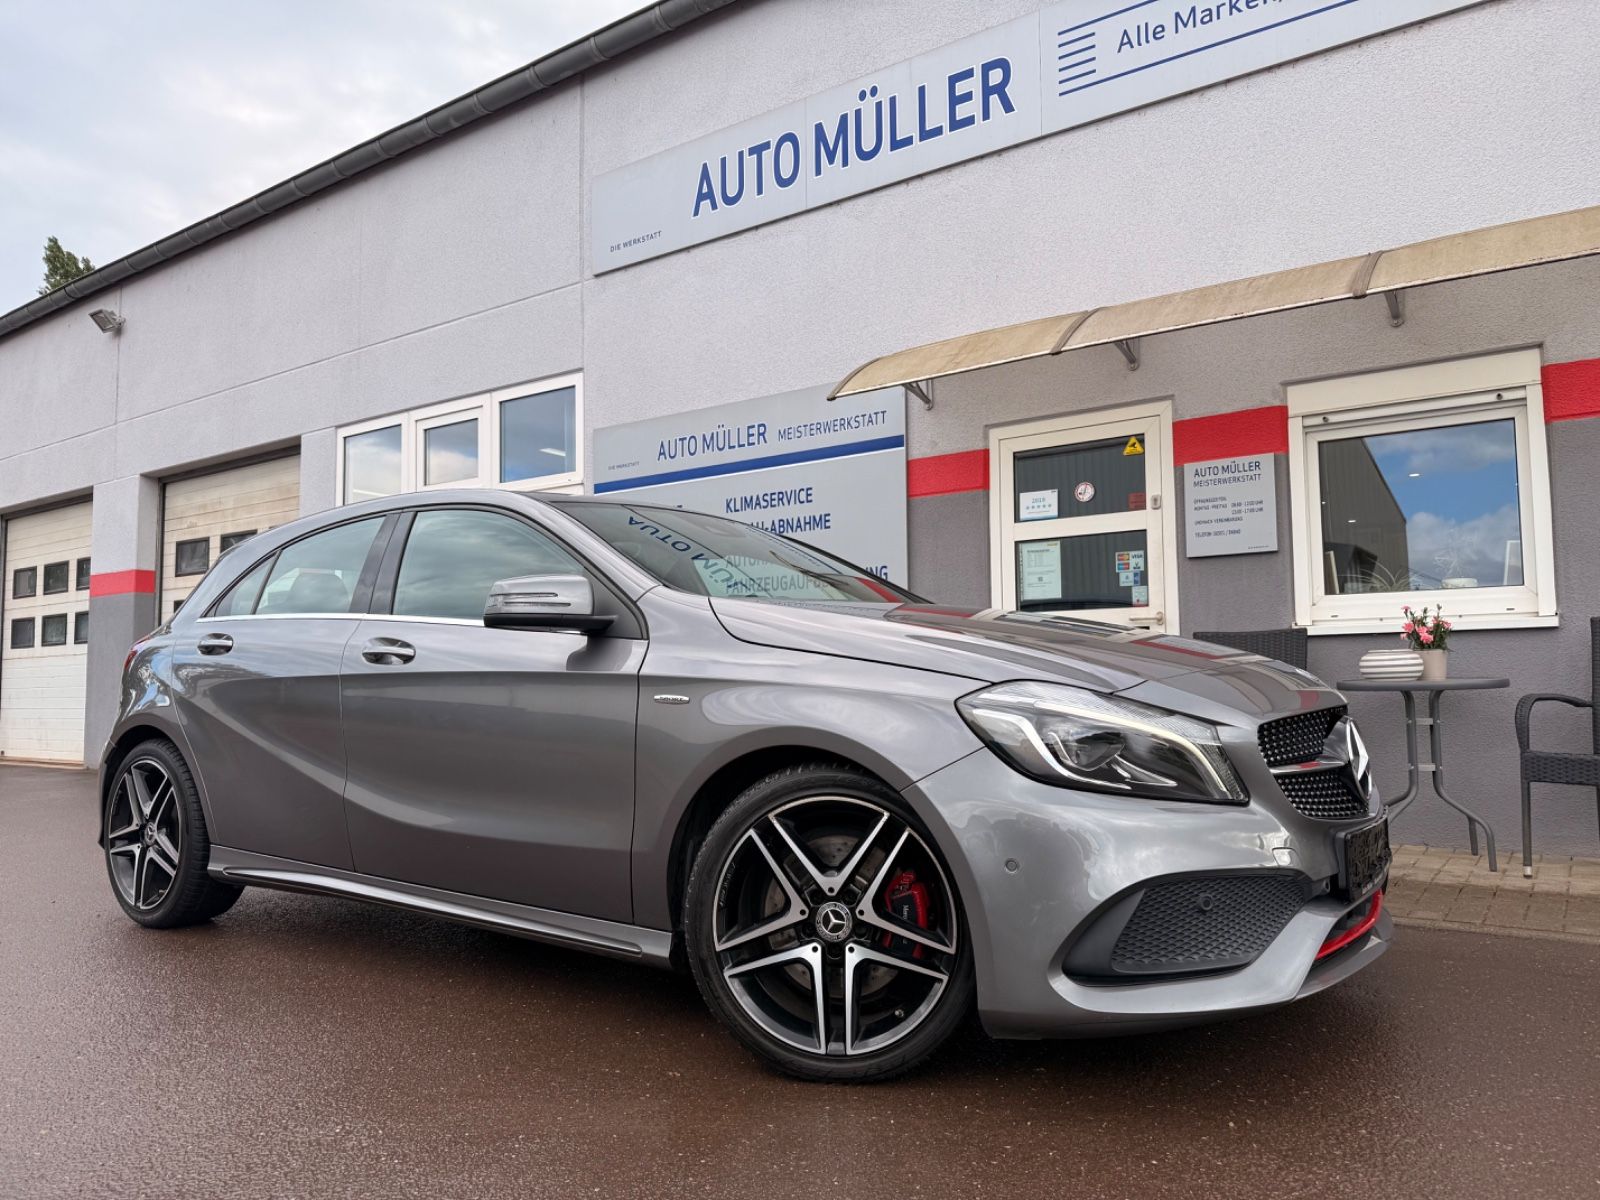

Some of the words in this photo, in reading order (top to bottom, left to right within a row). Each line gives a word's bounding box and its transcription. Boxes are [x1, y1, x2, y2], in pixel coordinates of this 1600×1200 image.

[1117, 21, 1166, 54] Alle
[691, 131, 801, 218] AUTO
[813, 56, 1016, 178] MÜLLER
[610, 243, 621, 253] DIE
[622, 230, 662, 248] WERKSTATT
[657, 434, 698, 462] AUTO
[702, 423, 768, 453] MÜLLER
[778, 410, 888, 442] MEISTERWERKSTATT
[1193, 474, 1261, 488] MEISTERWERKSTATT
[1194, 465, 1220, 478] AUTO
[1221, 460, 1261, 475] MÜLLER
[725, 487, 813, 513] KLIMASERVICE
